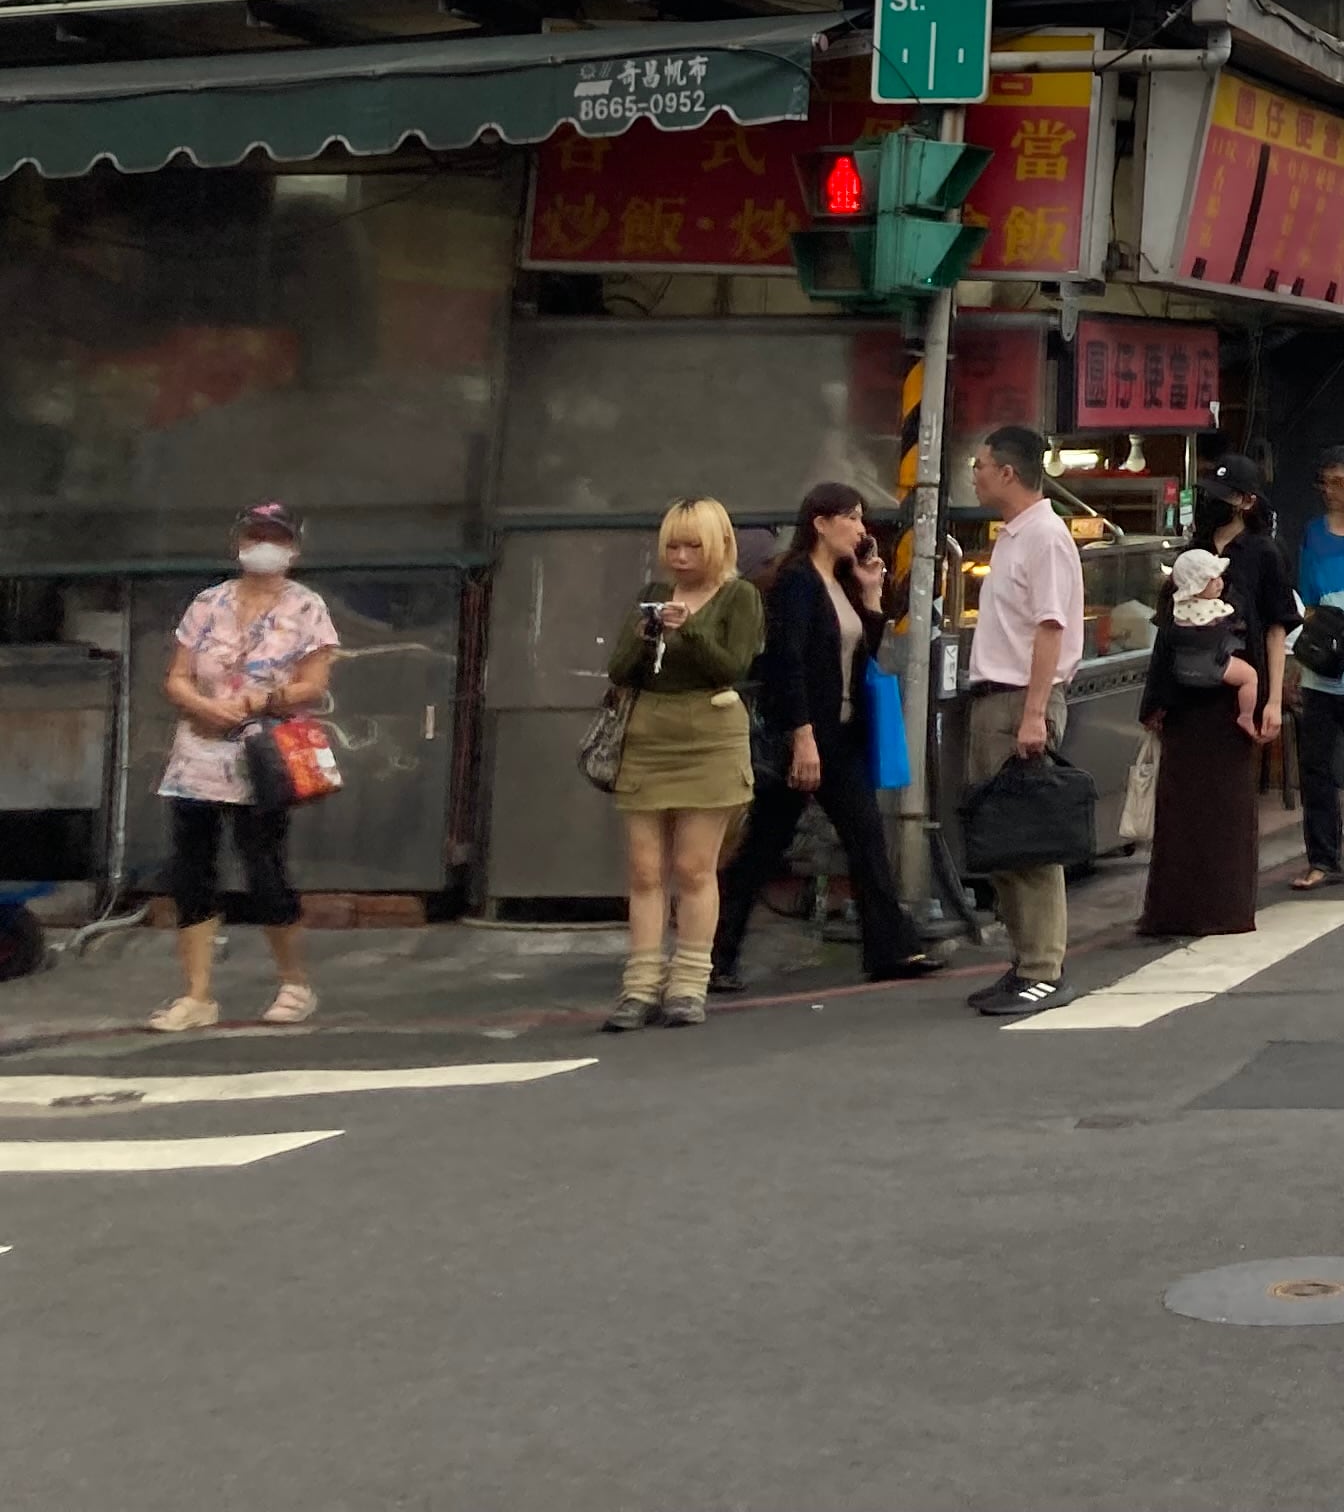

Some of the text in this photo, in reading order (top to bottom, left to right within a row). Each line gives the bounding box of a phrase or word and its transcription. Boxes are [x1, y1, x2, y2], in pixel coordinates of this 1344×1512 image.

[616, 55, 710, 93] 奇昌帆布
[578, 89, 707, 122] 8665-0952
